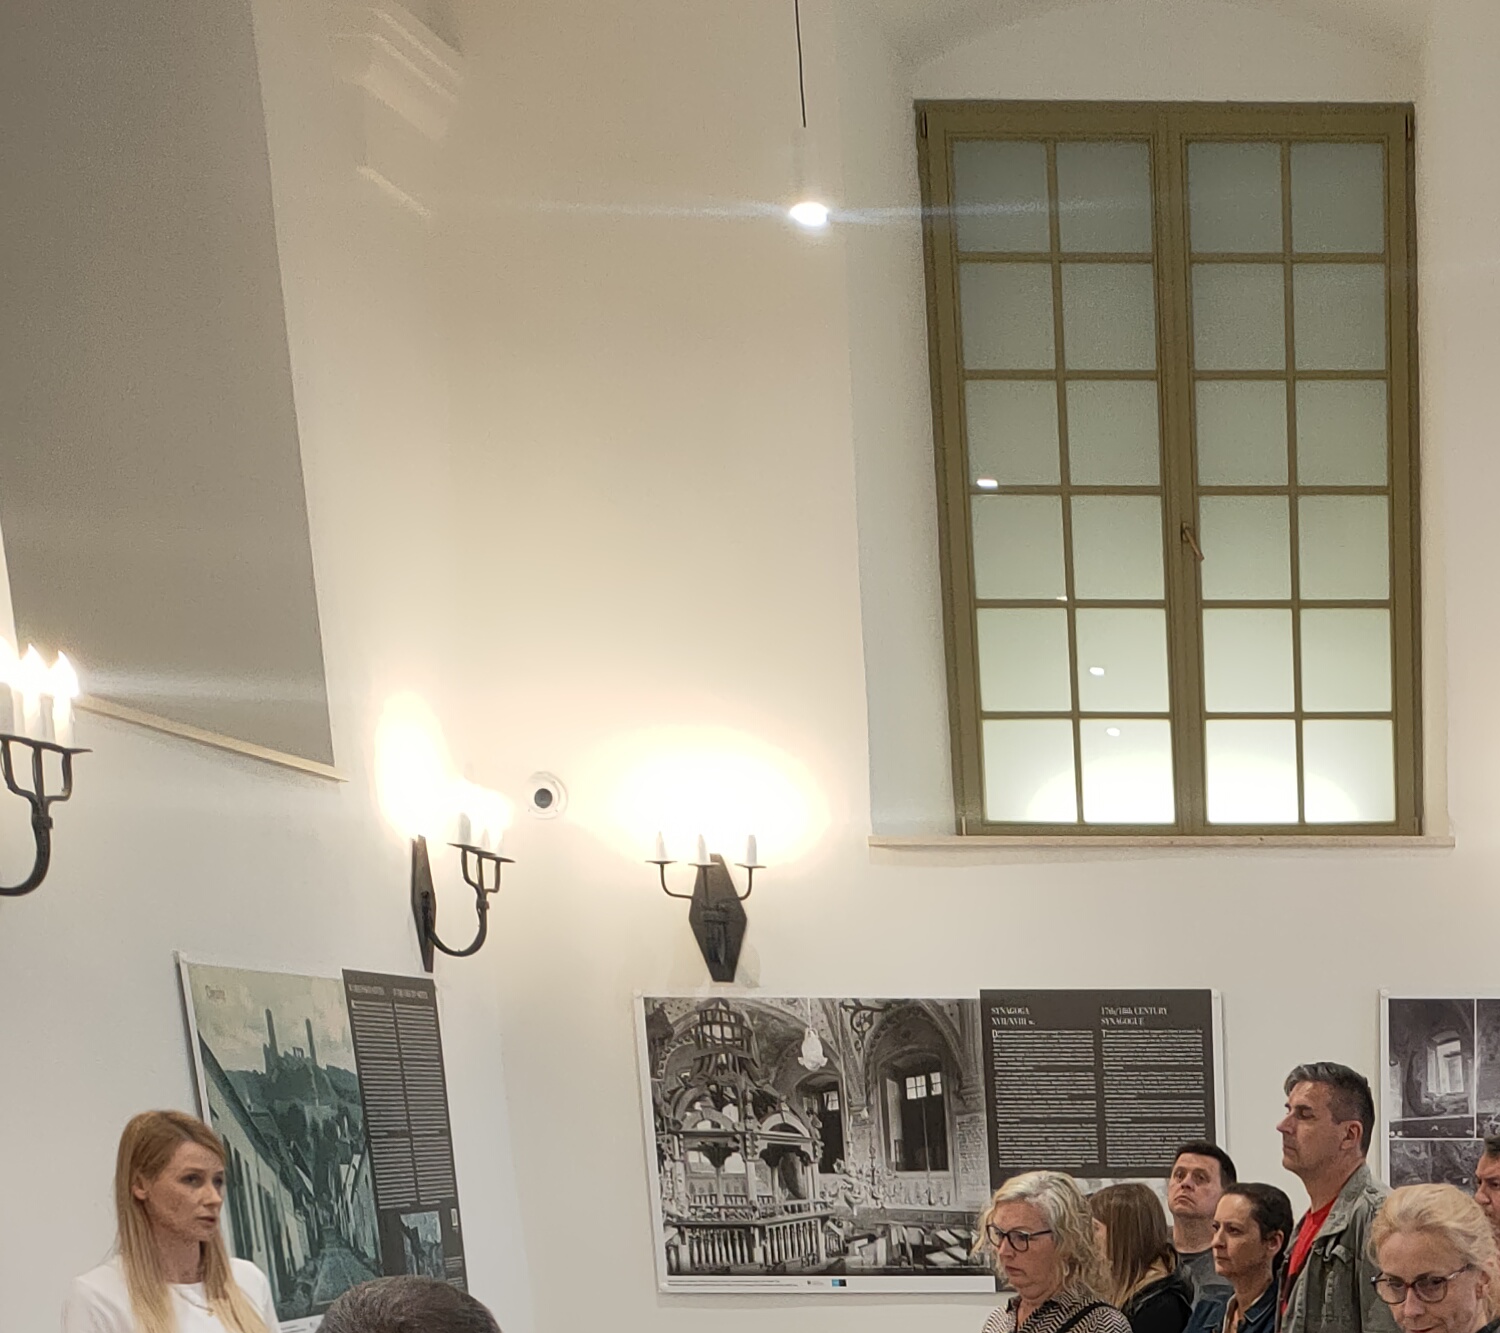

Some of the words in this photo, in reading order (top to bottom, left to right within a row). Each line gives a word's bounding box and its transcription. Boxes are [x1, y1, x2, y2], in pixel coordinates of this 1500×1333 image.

[991, 1006, 1030, 1015] SYNAGOGA
[1134, 1006, 1168, 1015] CENTURY
[1101, 1017, 1145, 1026] SYNAGOGUE
